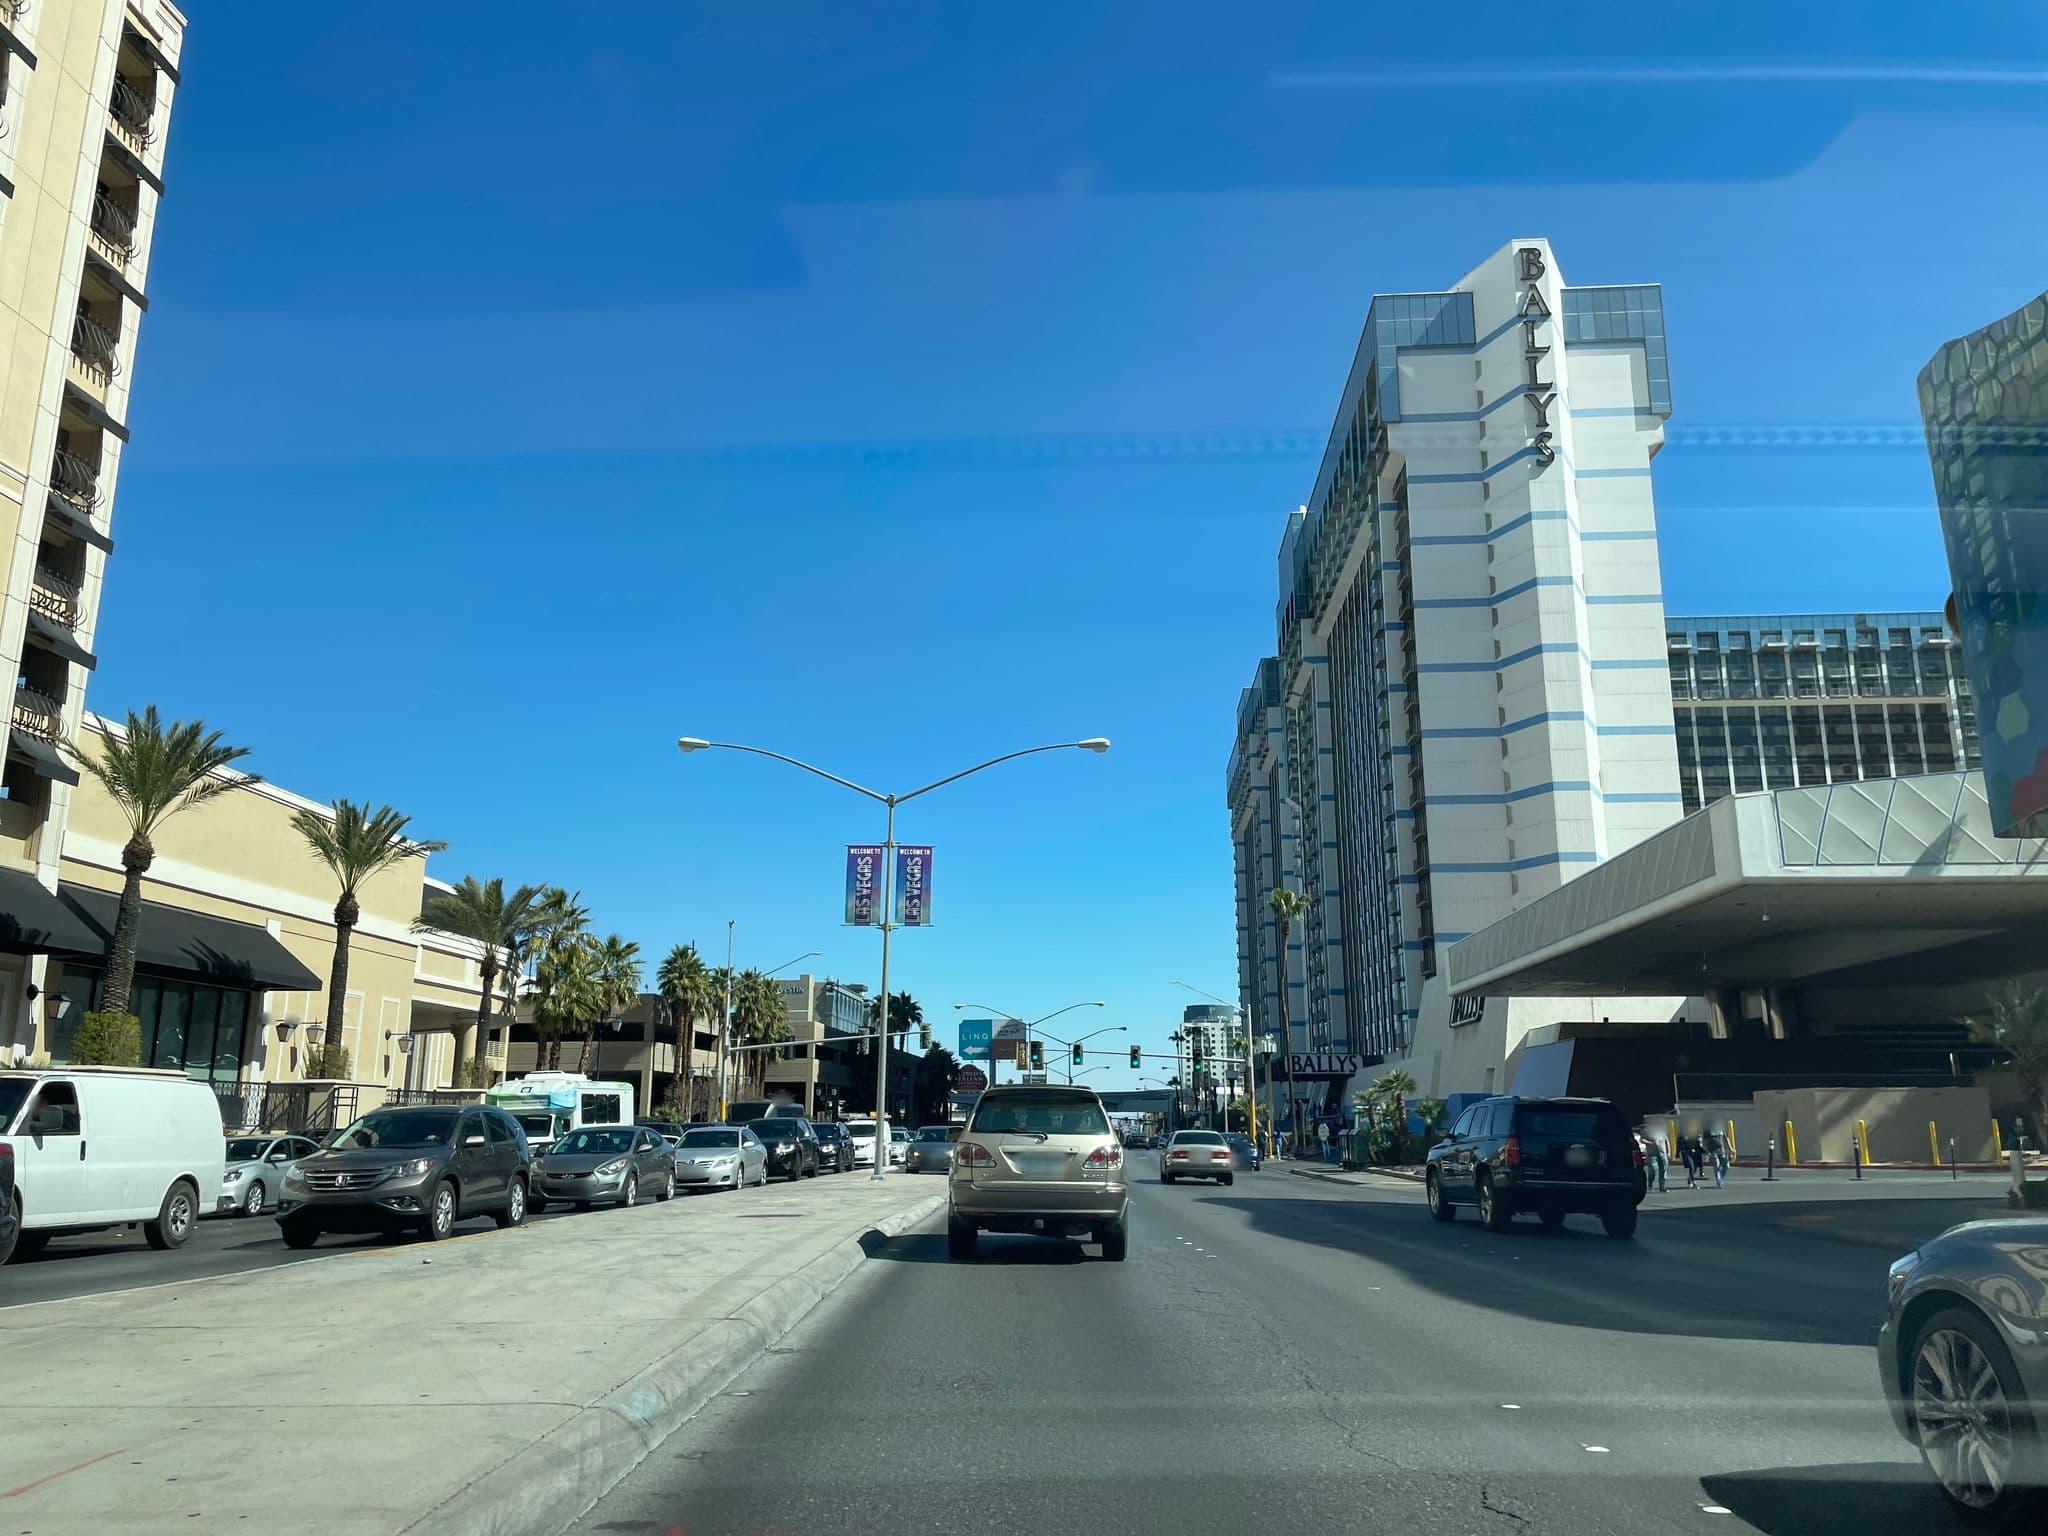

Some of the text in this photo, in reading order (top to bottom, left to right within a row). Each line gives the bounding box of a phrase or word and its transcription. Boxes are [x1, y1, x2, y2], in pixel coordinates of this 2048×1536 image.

[1518, 247, 1557, 467] BALLYS
[855, 856, 873, 923] LAS VEGAS
[905, 856, 922, 923] LAS VEGAS
[962, 1033, 989, 1041] LINQ
[1291, 1054, 1358, 1073] BALLYS
